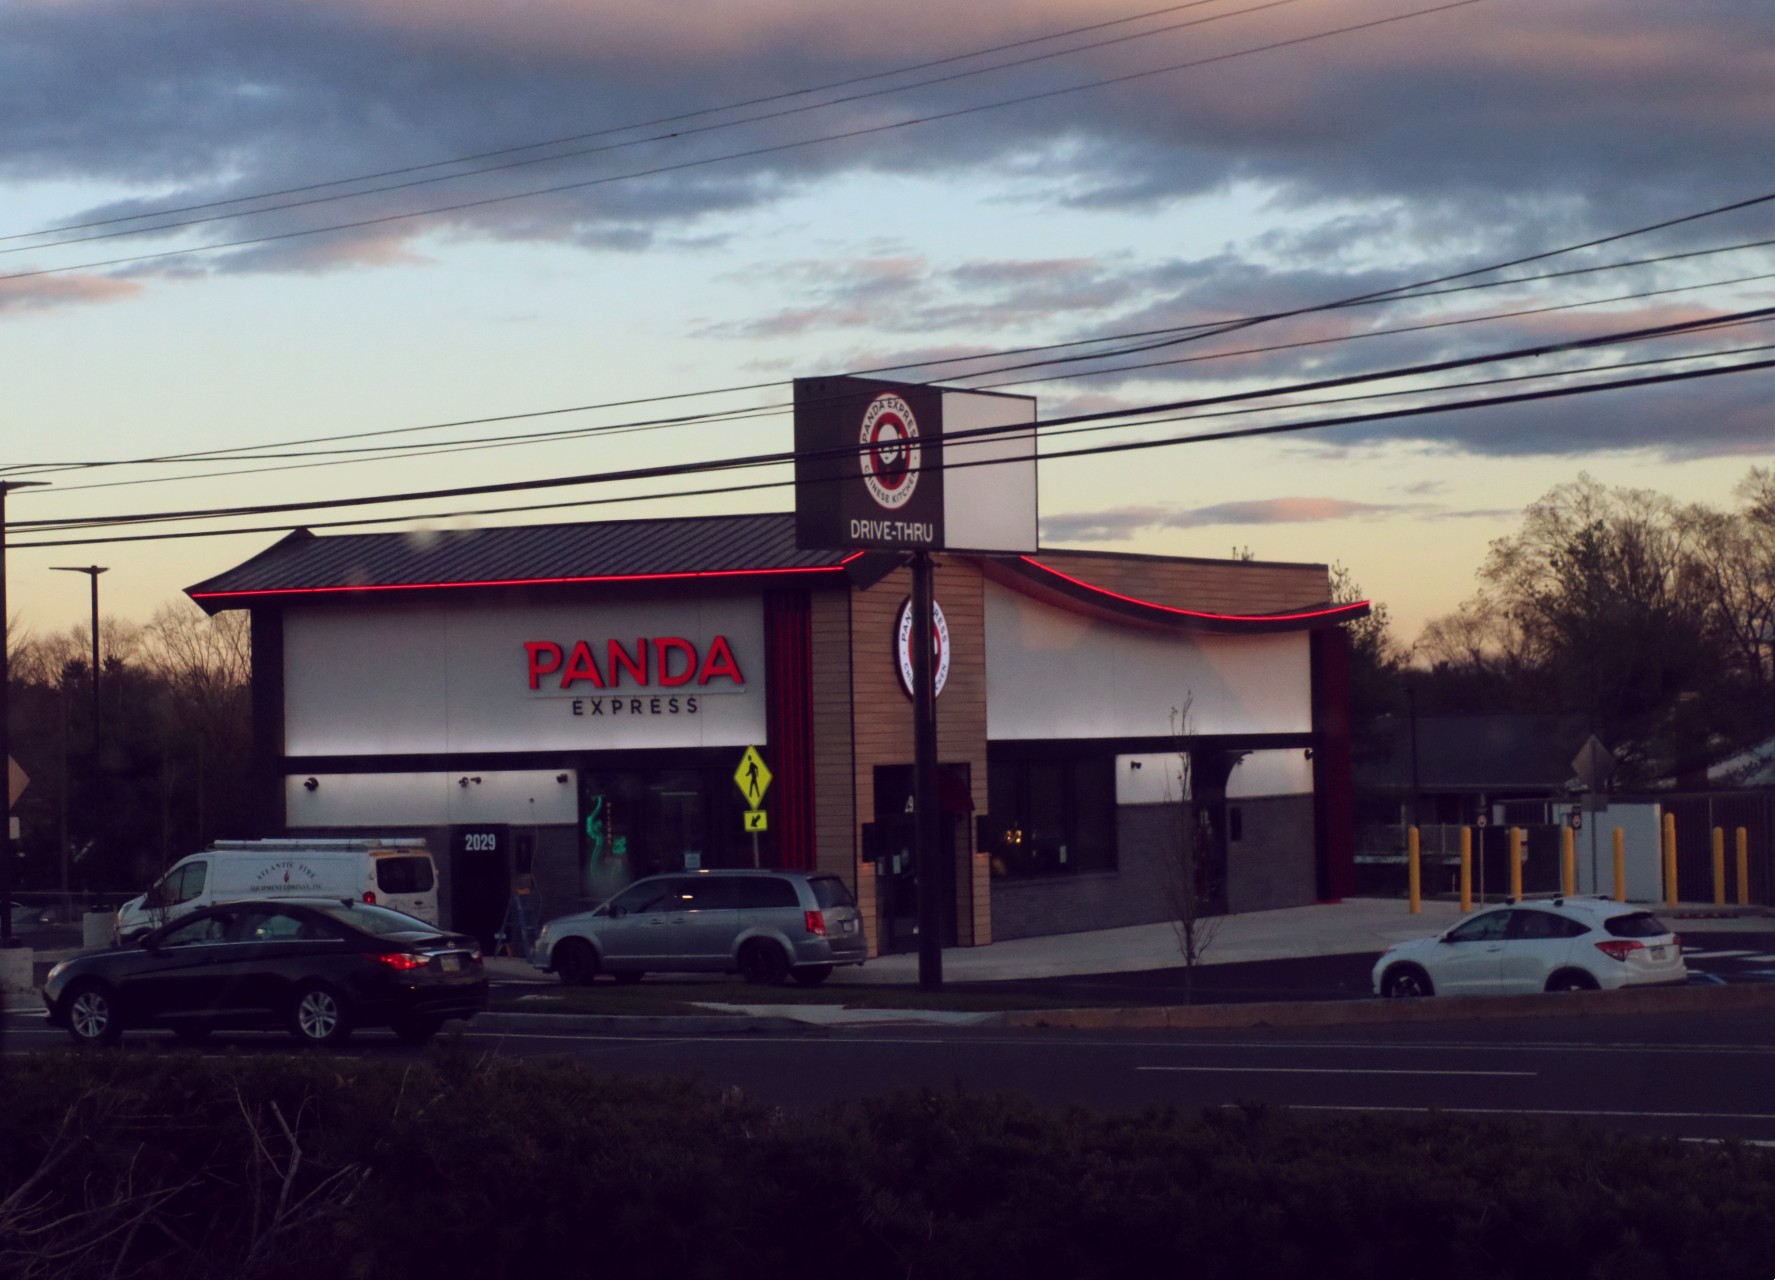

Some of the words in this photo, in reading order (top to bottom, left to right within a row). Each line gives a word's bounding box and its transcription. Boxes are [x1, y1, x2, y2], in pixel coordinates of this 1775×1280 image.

[862, 401, 885, 443] PANDA
[850, 519, 934, 543] DRIVE-THRU
[524, 634, 746, 690] PANDA
[572, 699, 698, 716] EXPRESS
[465, 833, 496, 851] 2029
[257, 862, 294, 880] ATLANTIC
